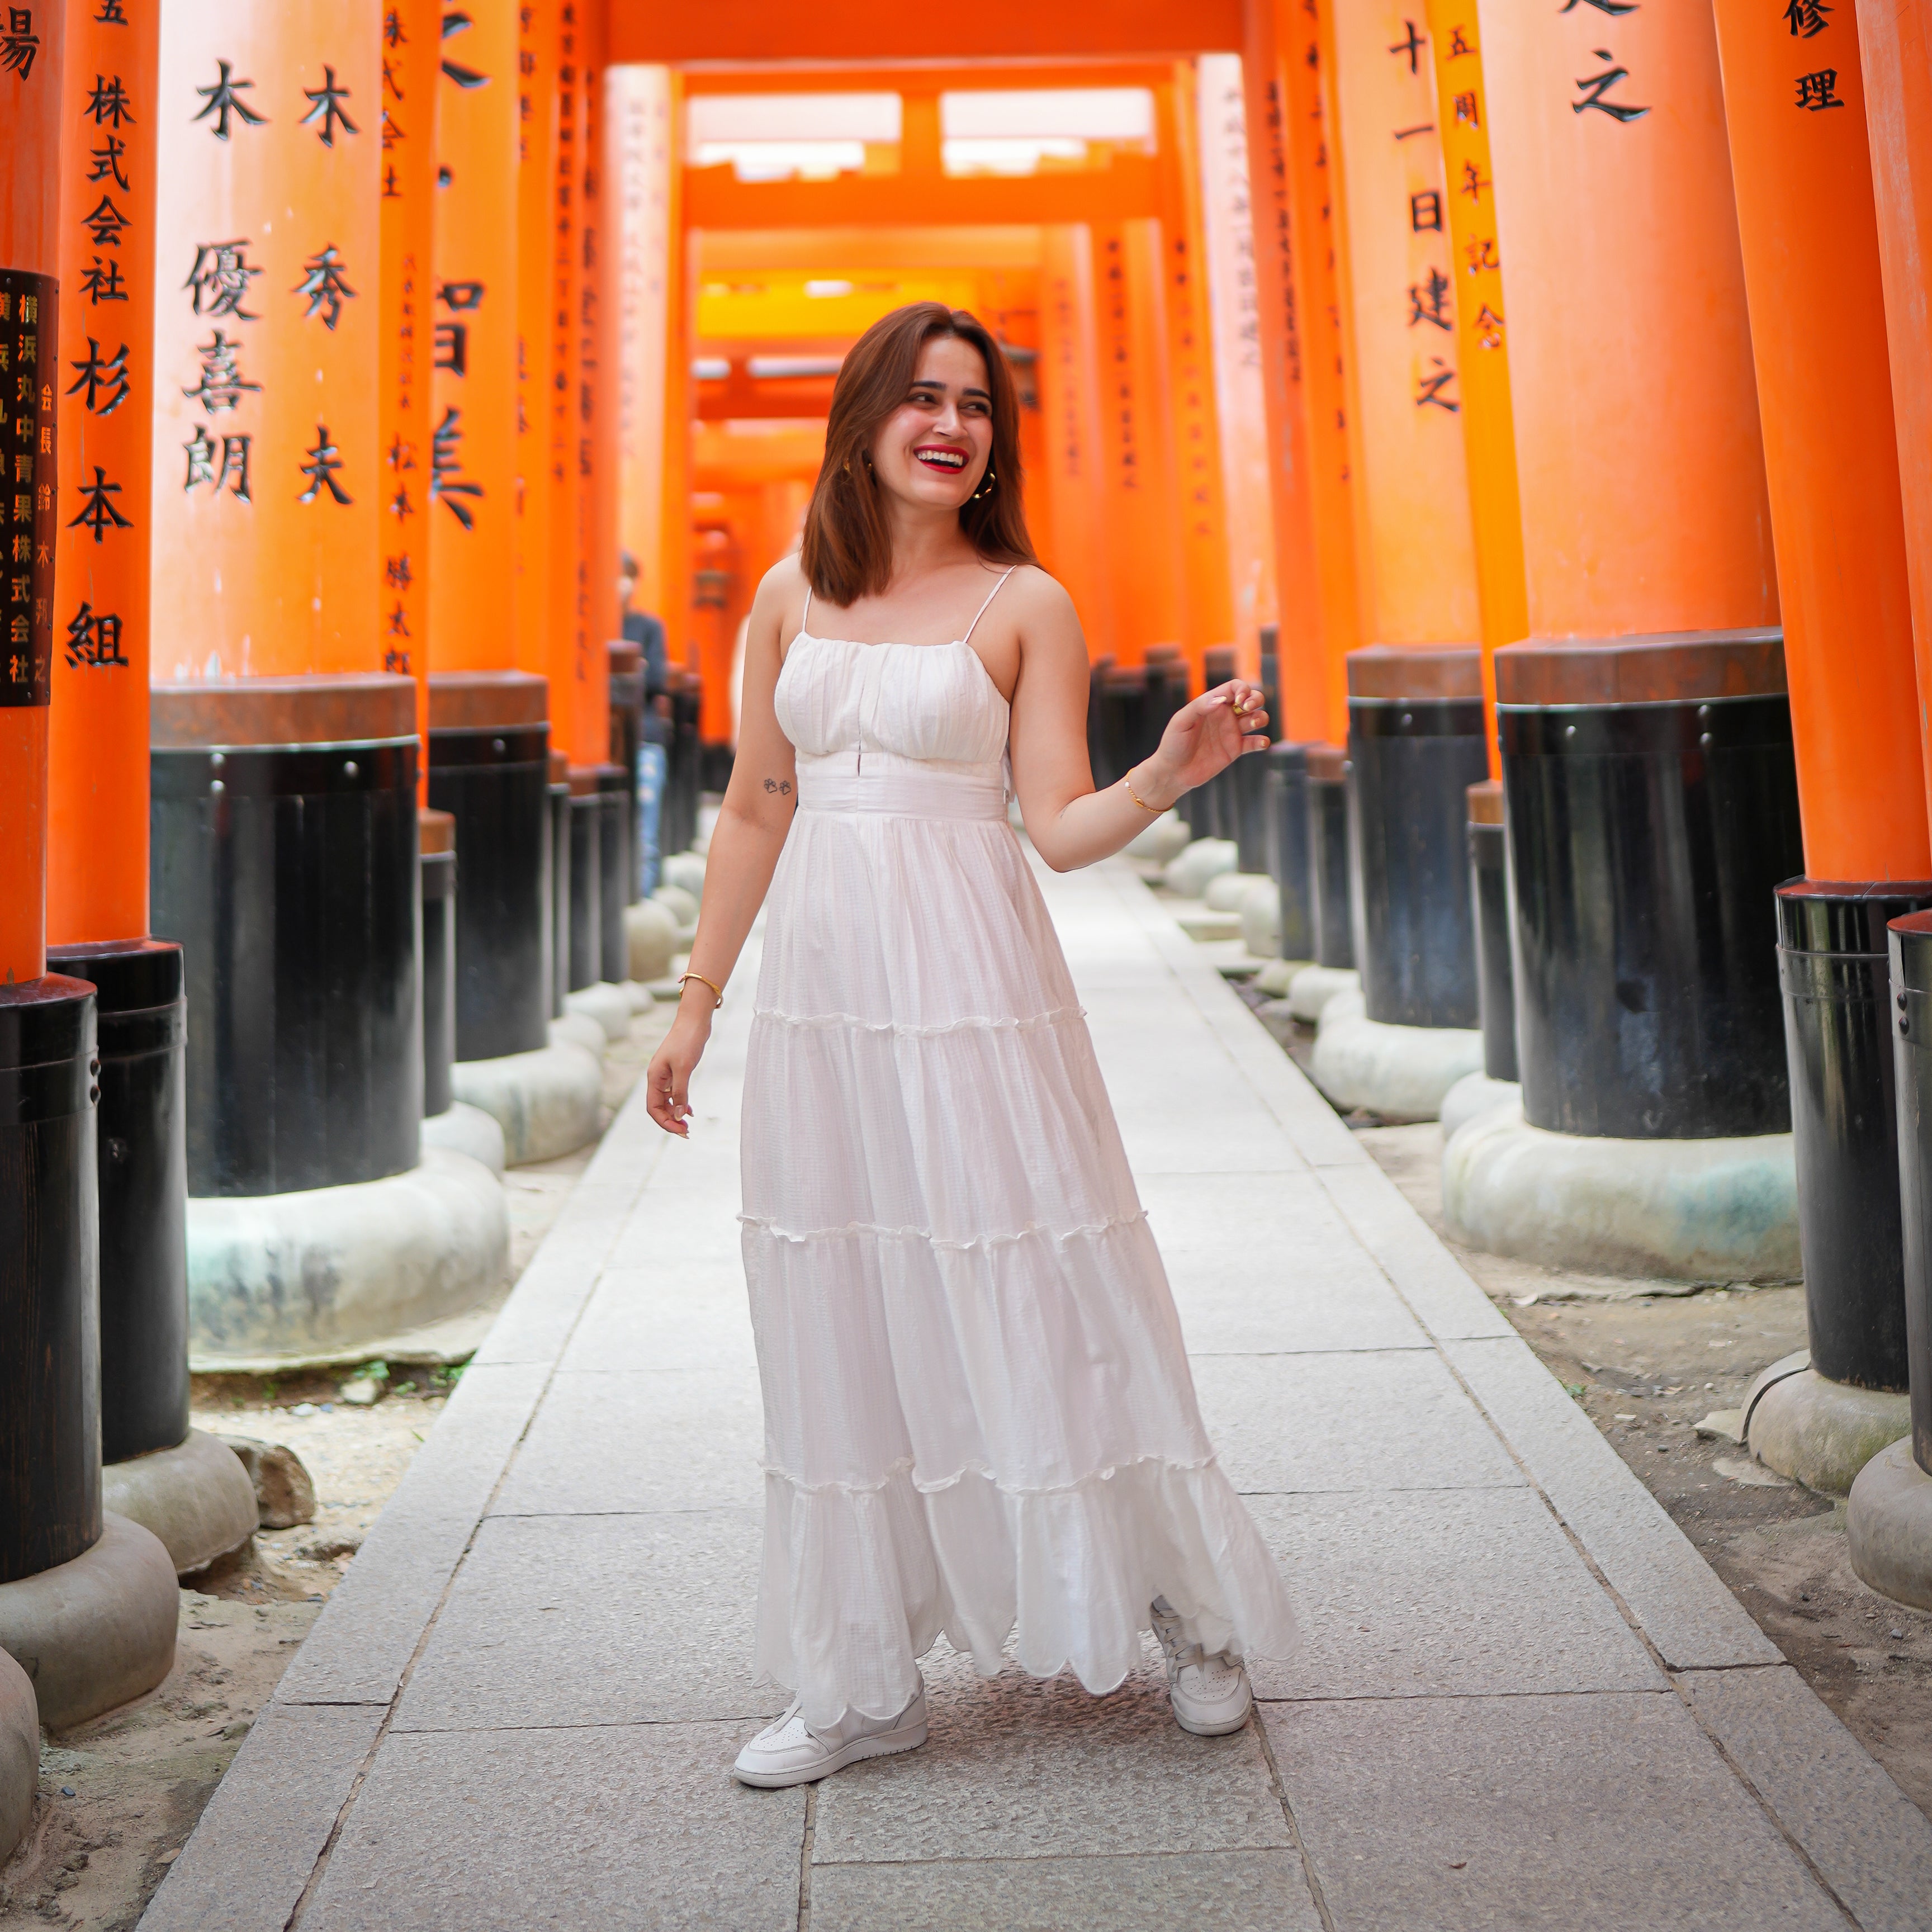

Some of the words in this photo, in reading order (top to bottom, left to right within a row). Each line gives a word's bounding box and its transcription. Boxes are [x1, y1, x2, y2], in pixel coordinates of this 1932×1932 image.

[1390, 21, 1460, 412] 十一日建之
[1446, 23, 1504, 351] 五周年記念
[1557, 0, 1651, 122] 之
[1782, 0, 1845, 111] 修理
[291, 65, 360, 505] 木秀夫
[9, 295, 38, 684] 横浜丸中青果株式会社
